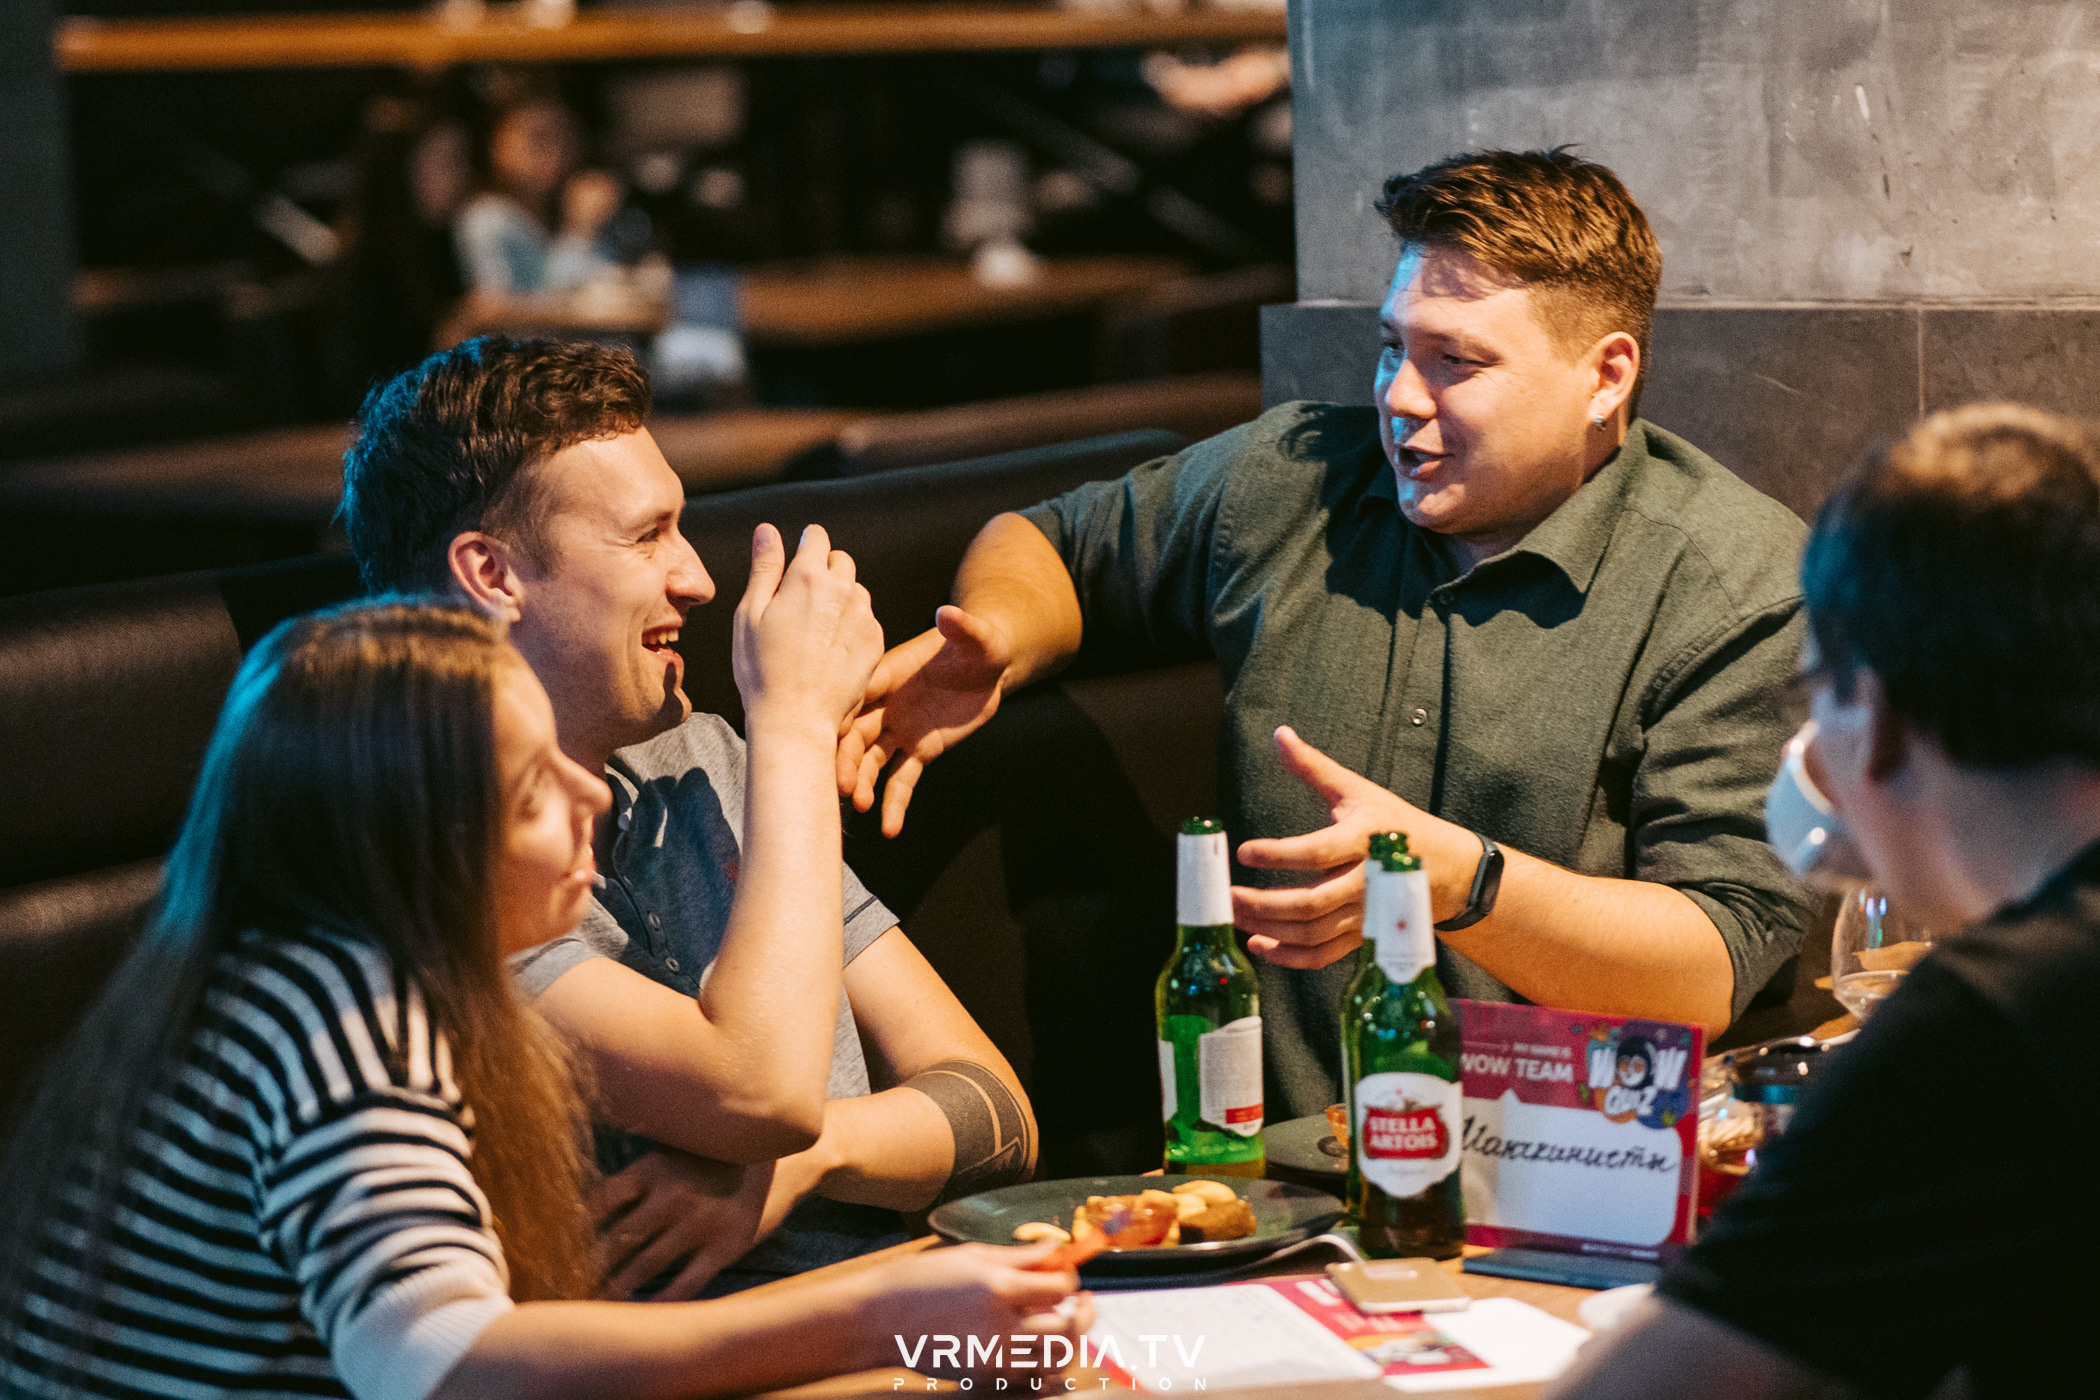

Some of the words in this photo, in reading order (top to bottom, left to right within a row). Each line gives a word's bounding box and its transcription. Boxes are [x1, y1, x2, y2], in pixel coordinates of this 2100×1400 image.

[1515, 1057, 1573, 1083] TEAM
[1604, 1085, 1659, 1116] QUIZ
[1368, 1116, 1437, 1132] STELLA
[1369, 1134, 1438, 1152] ARTOIS
